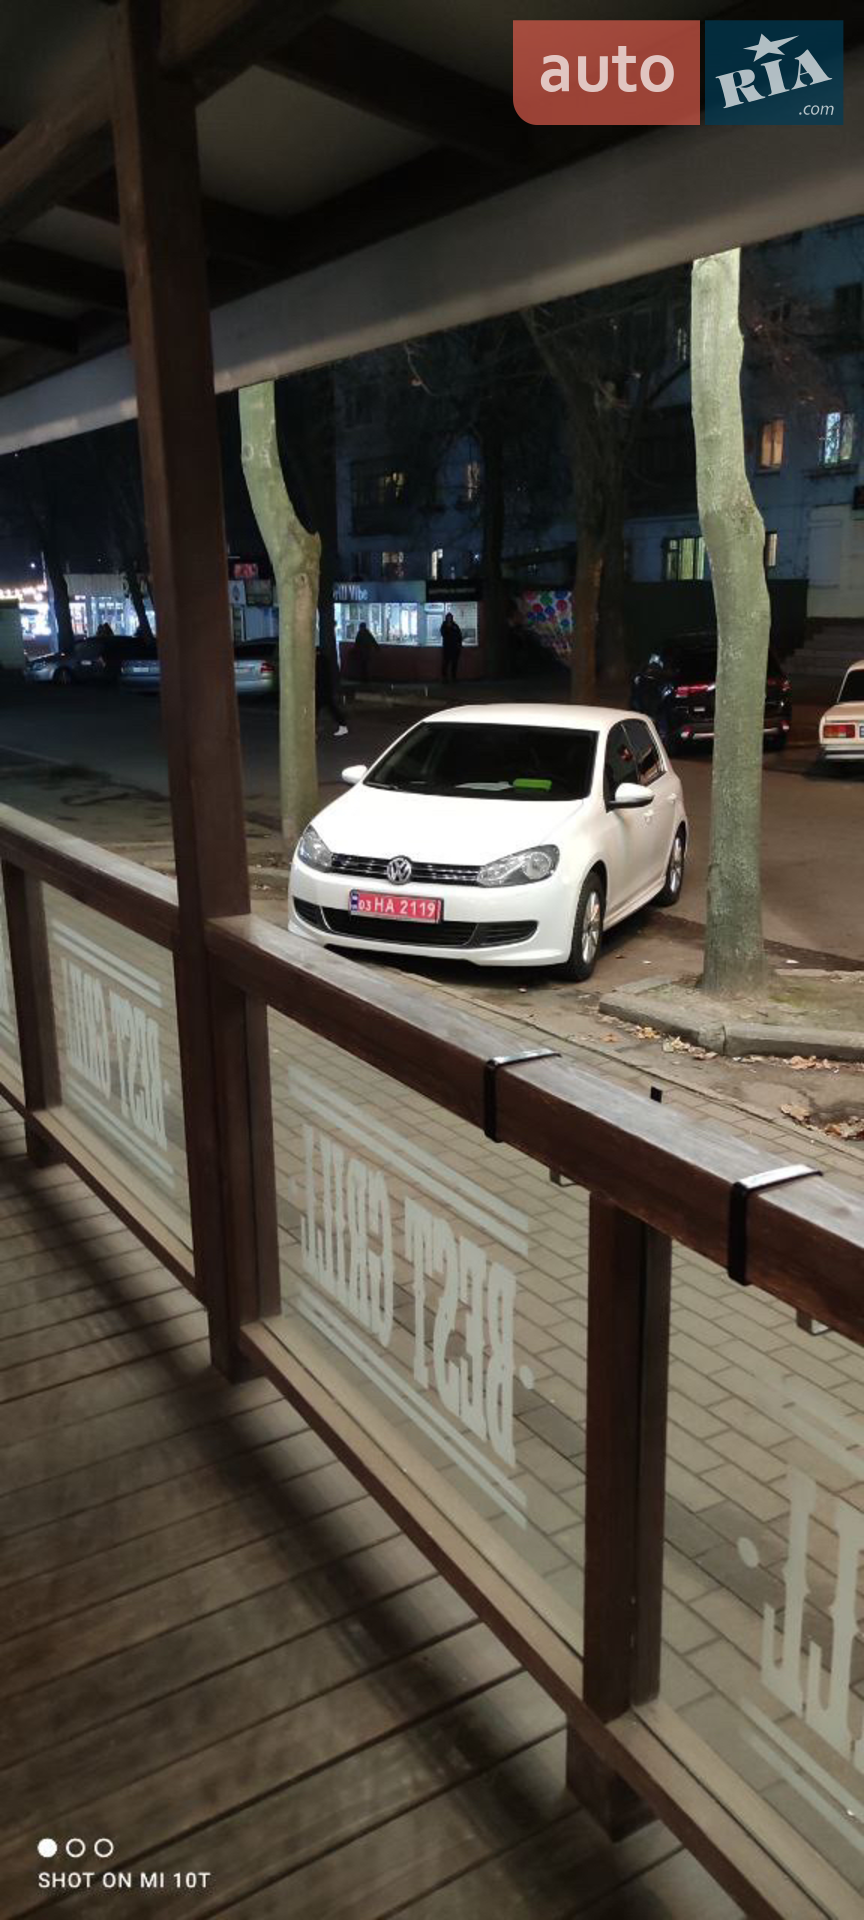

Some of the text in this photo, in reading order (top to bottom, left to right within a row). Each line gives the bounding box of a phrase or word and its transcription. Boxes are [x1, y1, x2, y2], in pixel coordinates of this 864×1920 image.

[348, 584, 369, 601] Vibe
[359, 899, 372, 912] 03
[374, 897, 395, 913] HA
[399, 899, 436, 918] 2119
